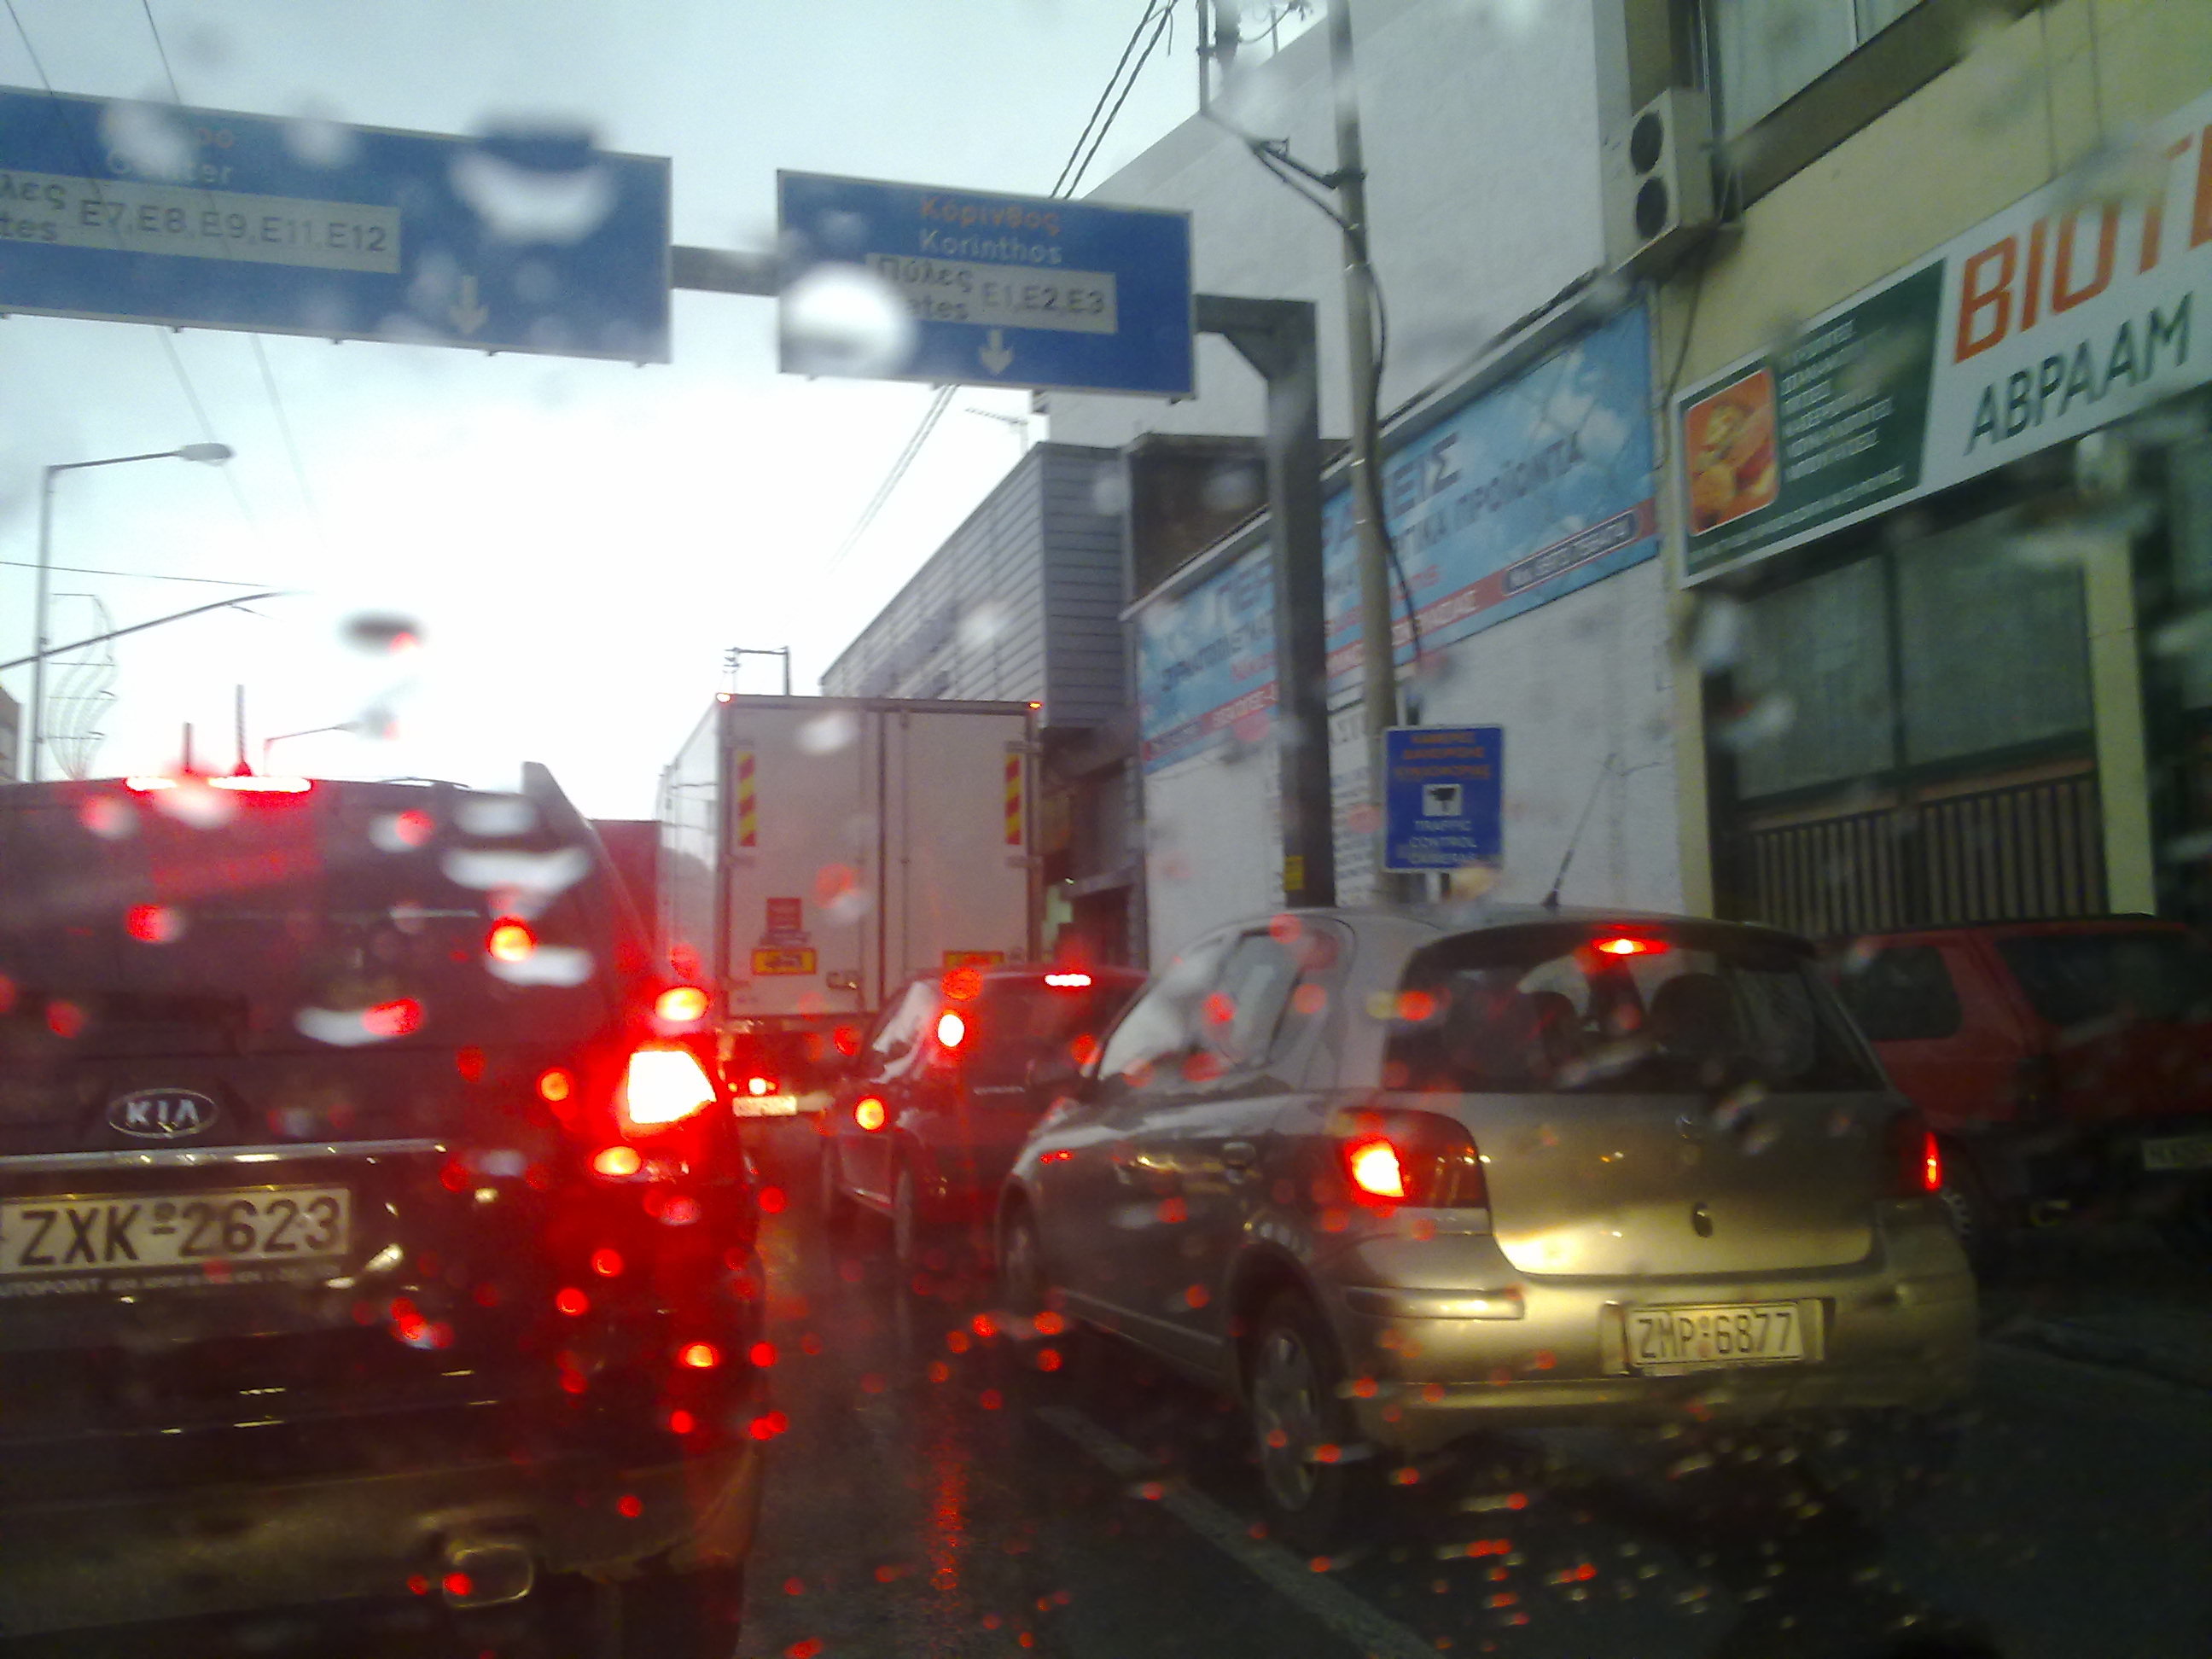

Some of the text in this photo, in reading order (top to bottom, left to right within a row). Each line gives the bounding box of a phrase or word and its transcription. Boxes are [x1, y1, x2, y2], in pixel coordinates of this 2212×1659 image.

[919, 227, 1063, 265] Korinthos
[1963, 290, 2194, 457] ΑΒΡΑΑΜ
[126, 1098, 200, 1127] KIA
